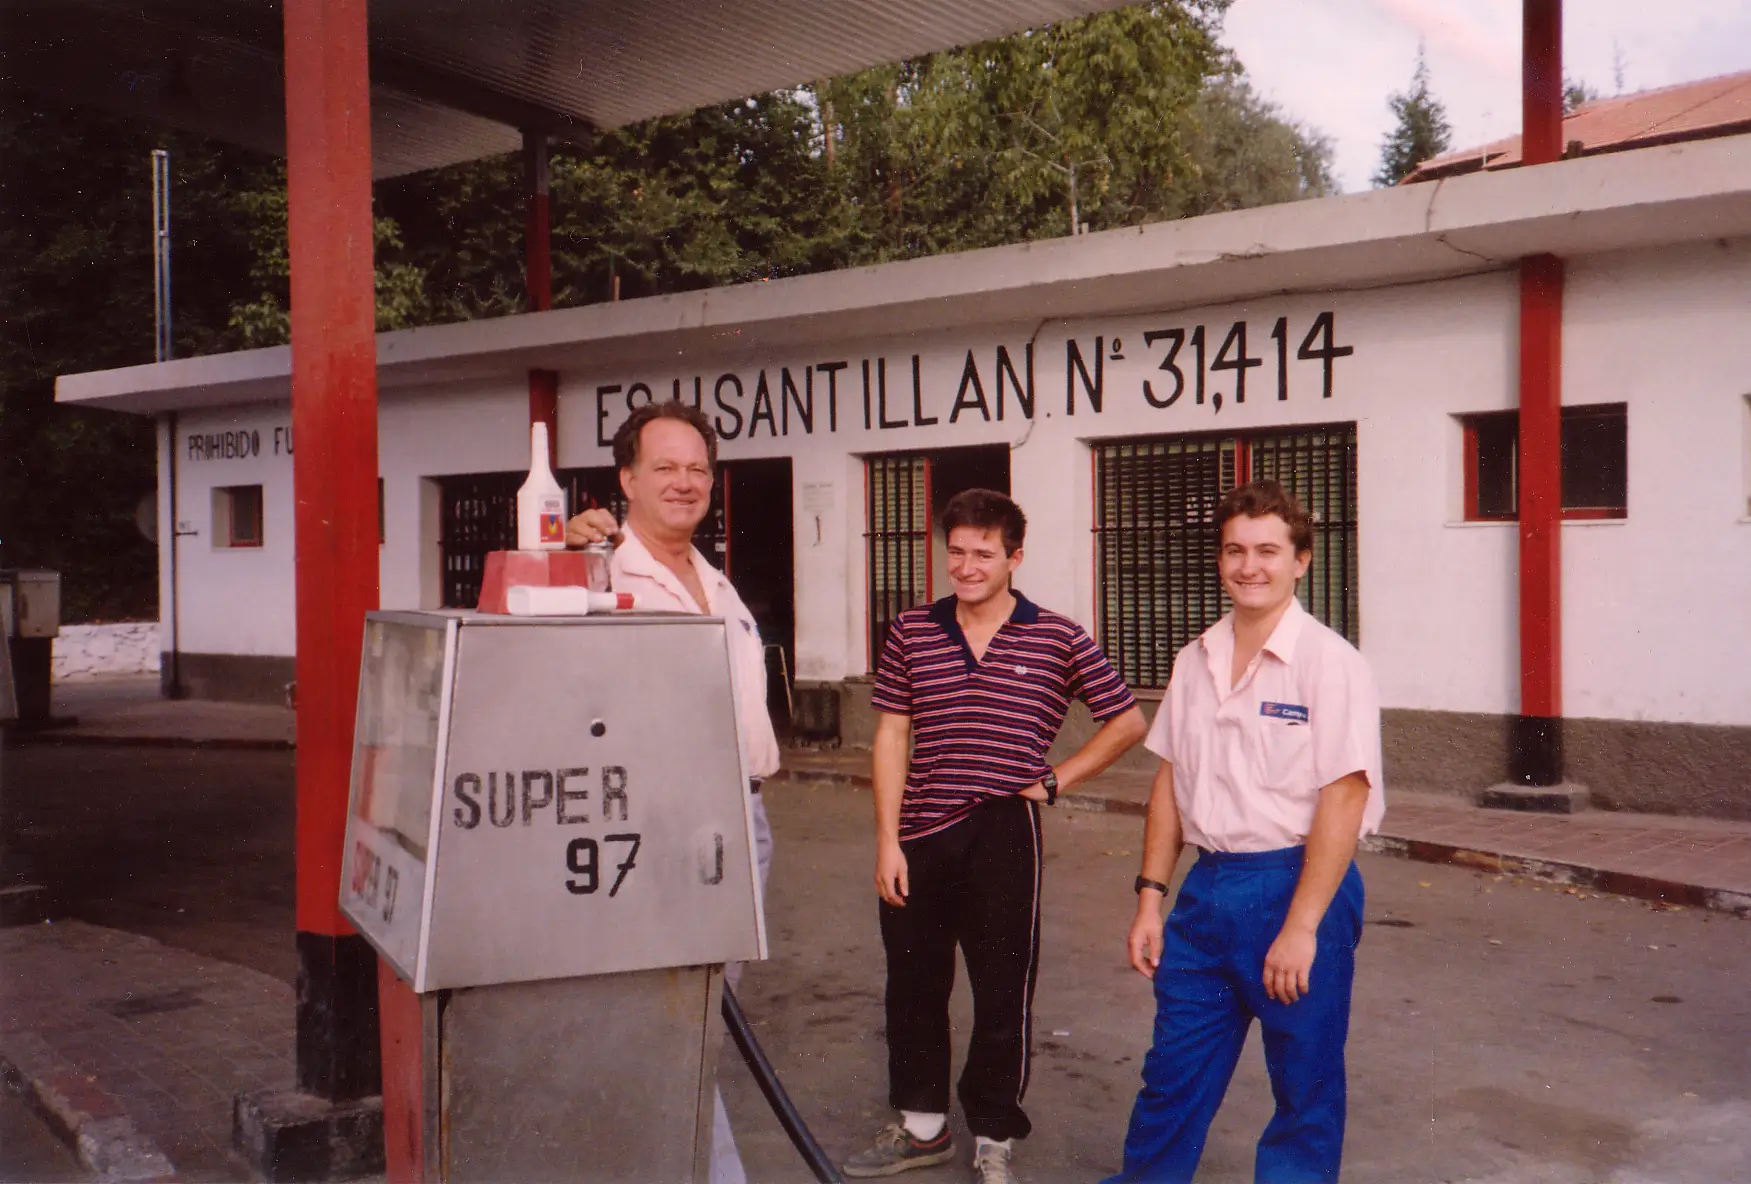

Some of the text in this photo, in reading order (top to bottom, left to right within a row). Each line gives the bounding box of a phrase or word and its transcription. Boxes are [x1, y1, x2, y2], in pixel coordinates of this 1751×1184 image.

[188, 429, 260, 461] PROHIBIDO
[453, 765, 629, 830] SUPER
[565, 833, 642, 898] 97
